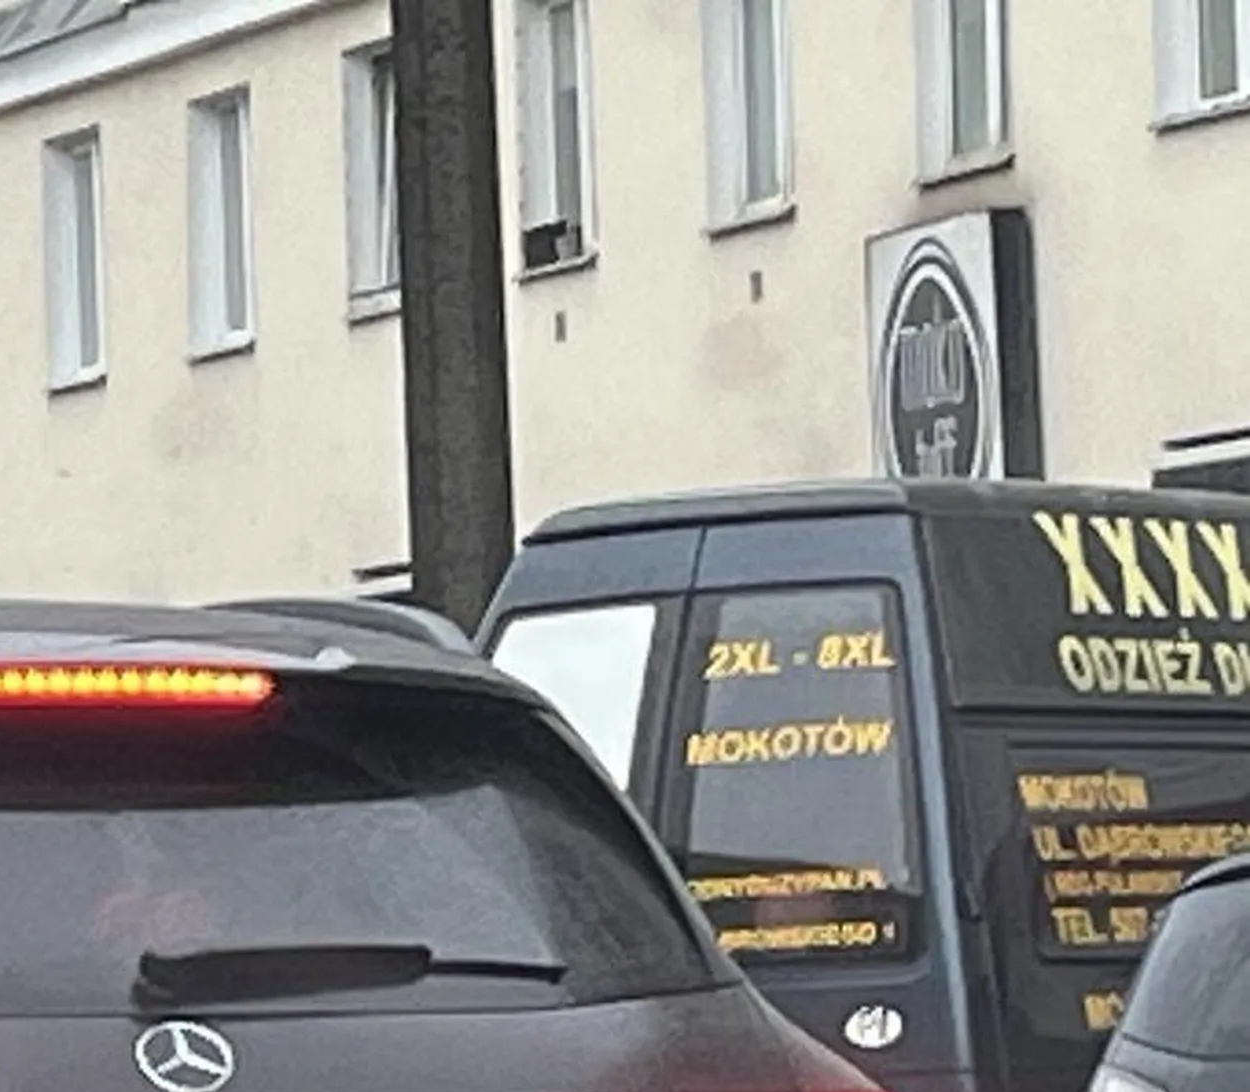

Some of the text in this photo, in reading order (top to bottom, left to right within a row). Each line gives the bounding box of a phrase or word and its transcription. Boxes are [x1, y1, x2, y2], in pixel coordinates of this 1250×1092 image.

[1032, 511, 1250, 621] XXXX
[703, 640, 782, 680] 2XL
[1058, 627, 1214, 694] ODZIEŻ
[686, 713, 894, 766] MOKOTÓW
